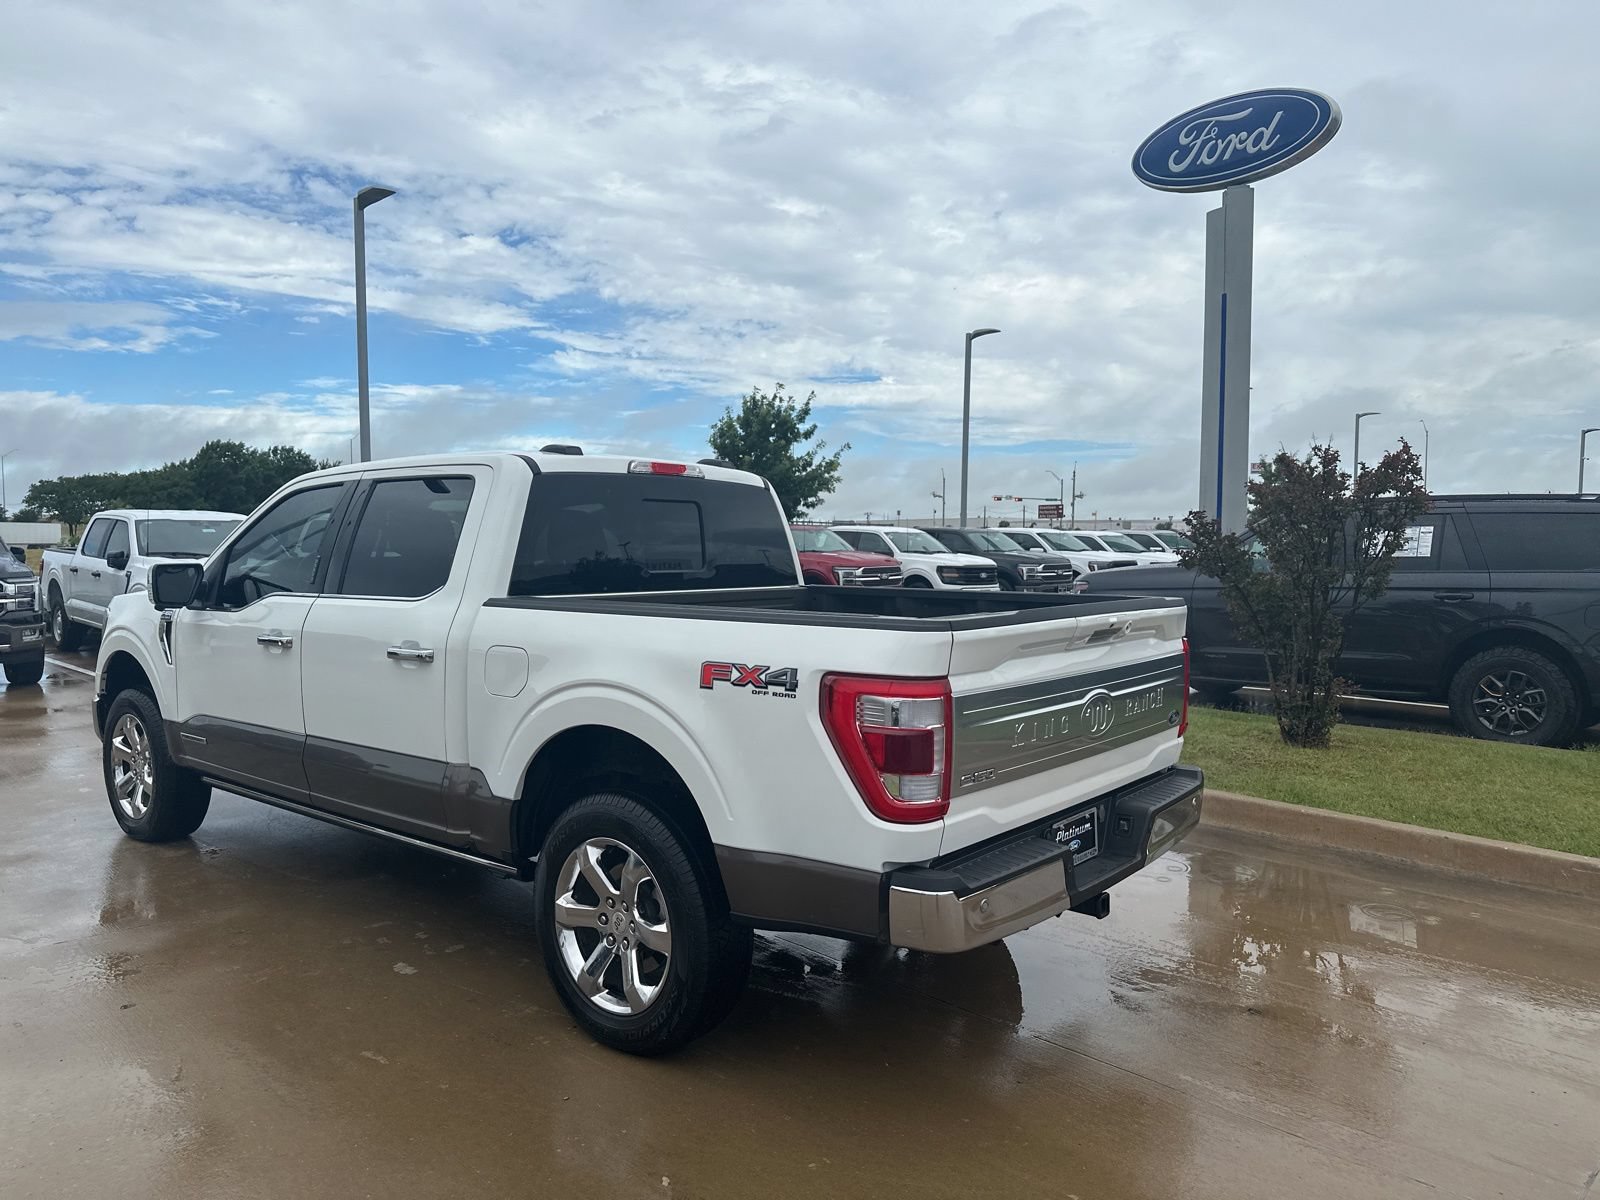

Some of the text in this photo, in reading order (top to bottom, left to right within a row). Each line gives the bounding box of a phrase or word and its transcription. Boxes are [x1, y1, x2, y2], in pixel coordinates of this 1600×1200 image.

[1168, 107, 1284, 173] Ford
[699, 661, 798, 692] FX4
[772, 690, 797, 699] ROAD
[1012, 715, 1069, 748] KING
[1124, 687, 1164, 717] RANCH
[1055, 822, 1093, 844] Platinum
